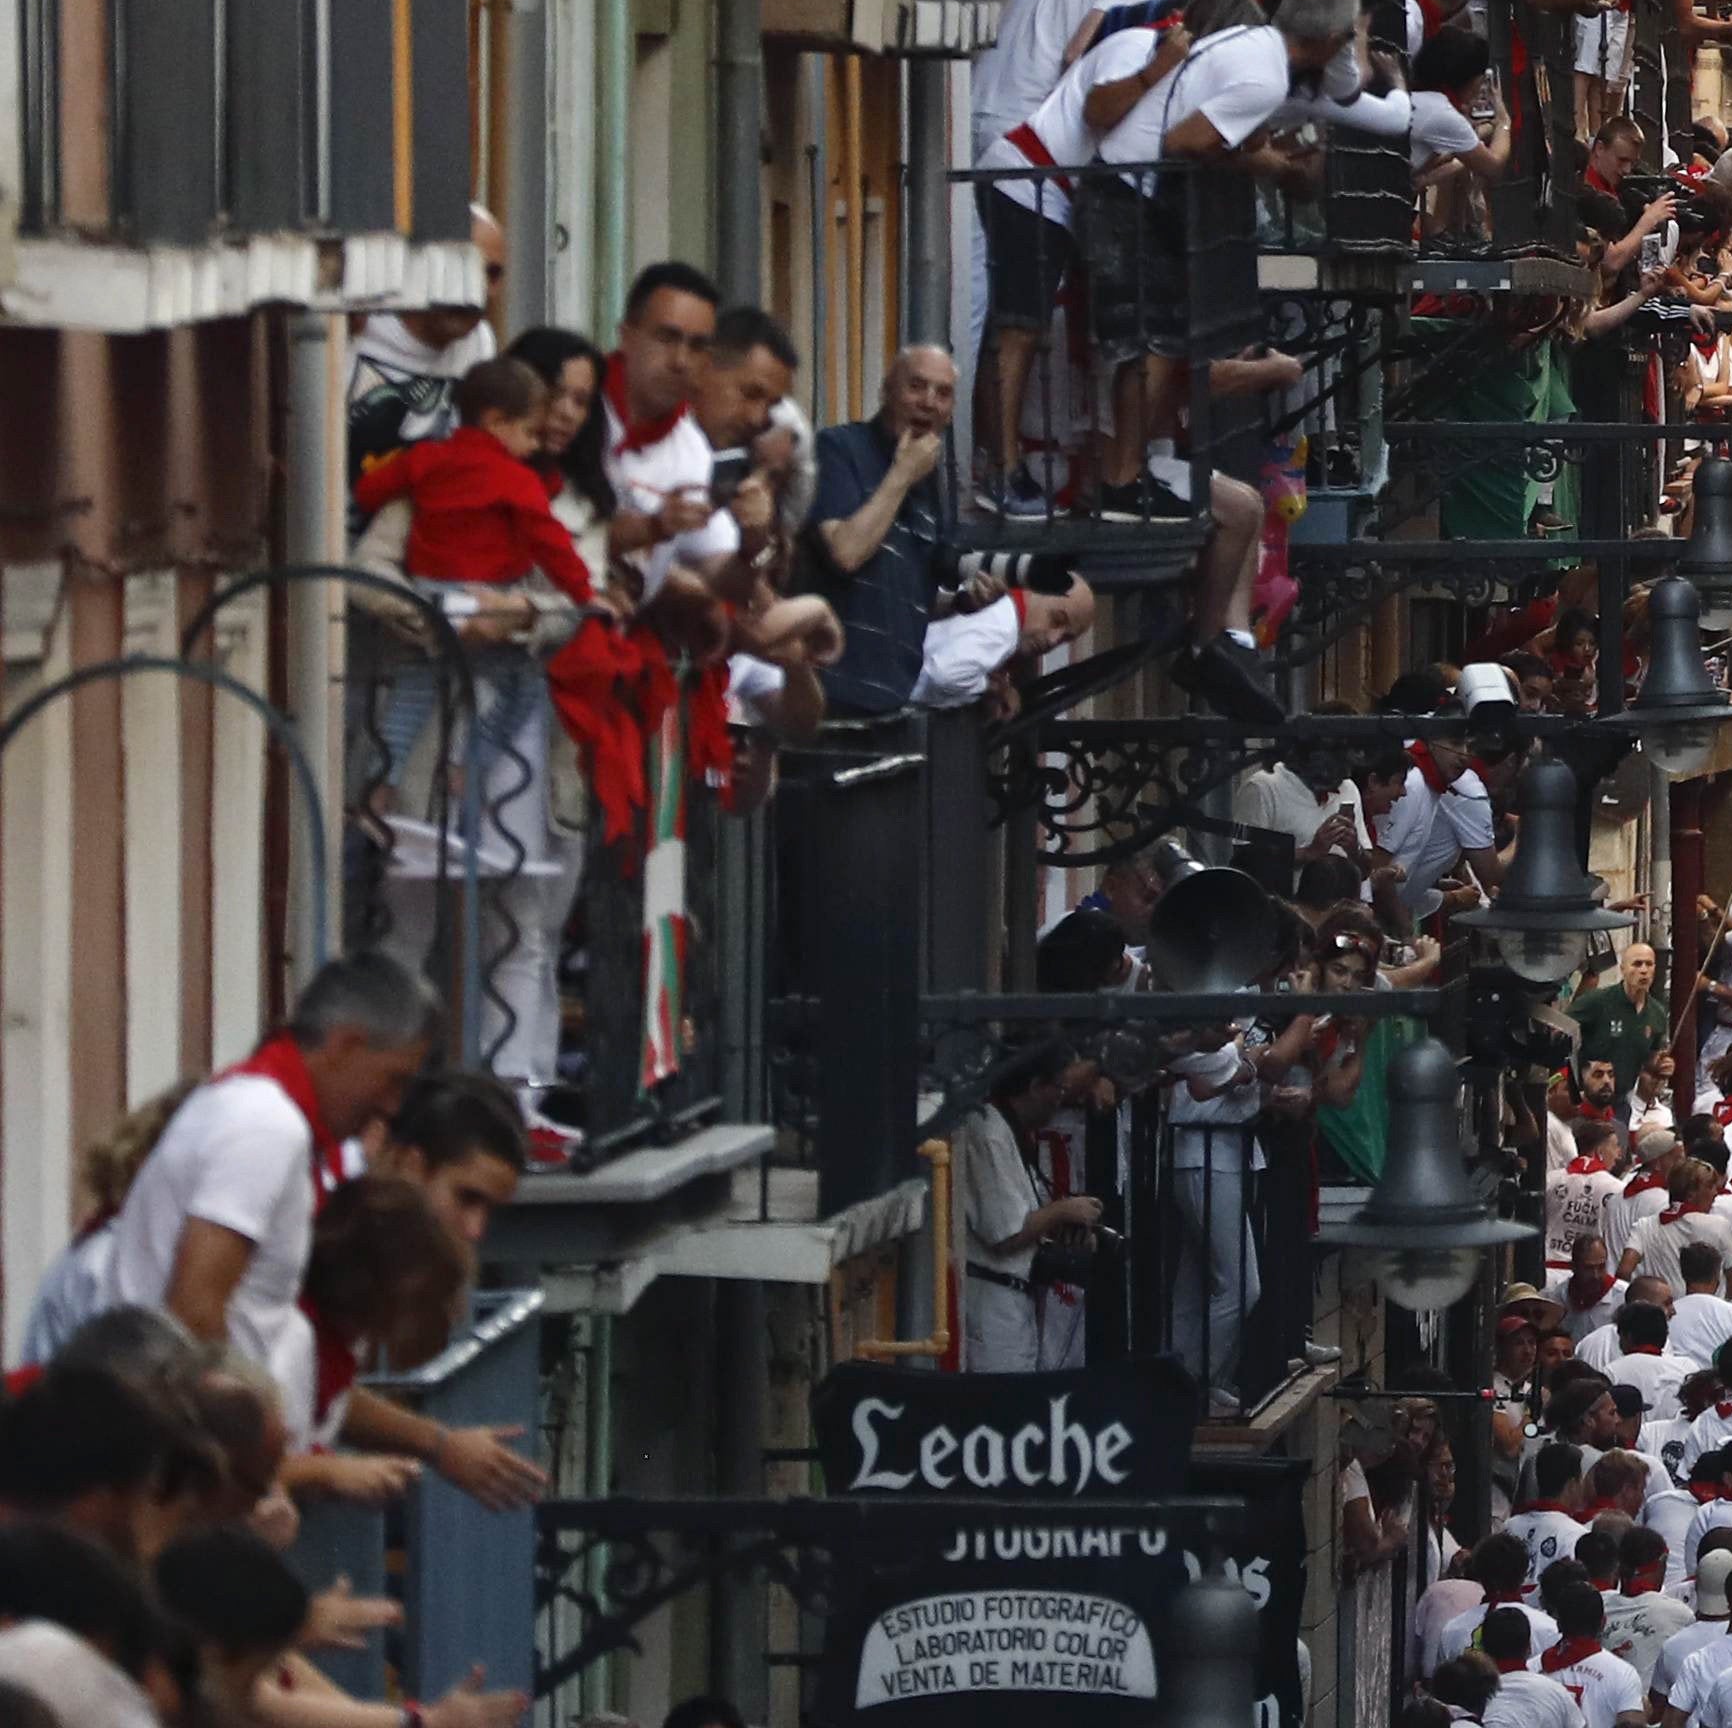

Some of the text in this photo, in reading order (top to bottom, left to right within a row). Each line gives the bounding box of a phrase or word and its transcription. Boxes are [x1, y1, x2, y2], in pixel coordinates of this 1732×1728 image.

[1563, 1212, 1598, 1227] CALM
[1567, 1200, 1599, 1215] FUCK
[850, 1393, 1133, 1496] Leache
[880, 1598, 976, 1639] ESTUDIO
[895, 1627, 1128, 1666] LABORATORIO COLOR
[881, 1661, 1129, 1697] VENTA DE MATERIAL
